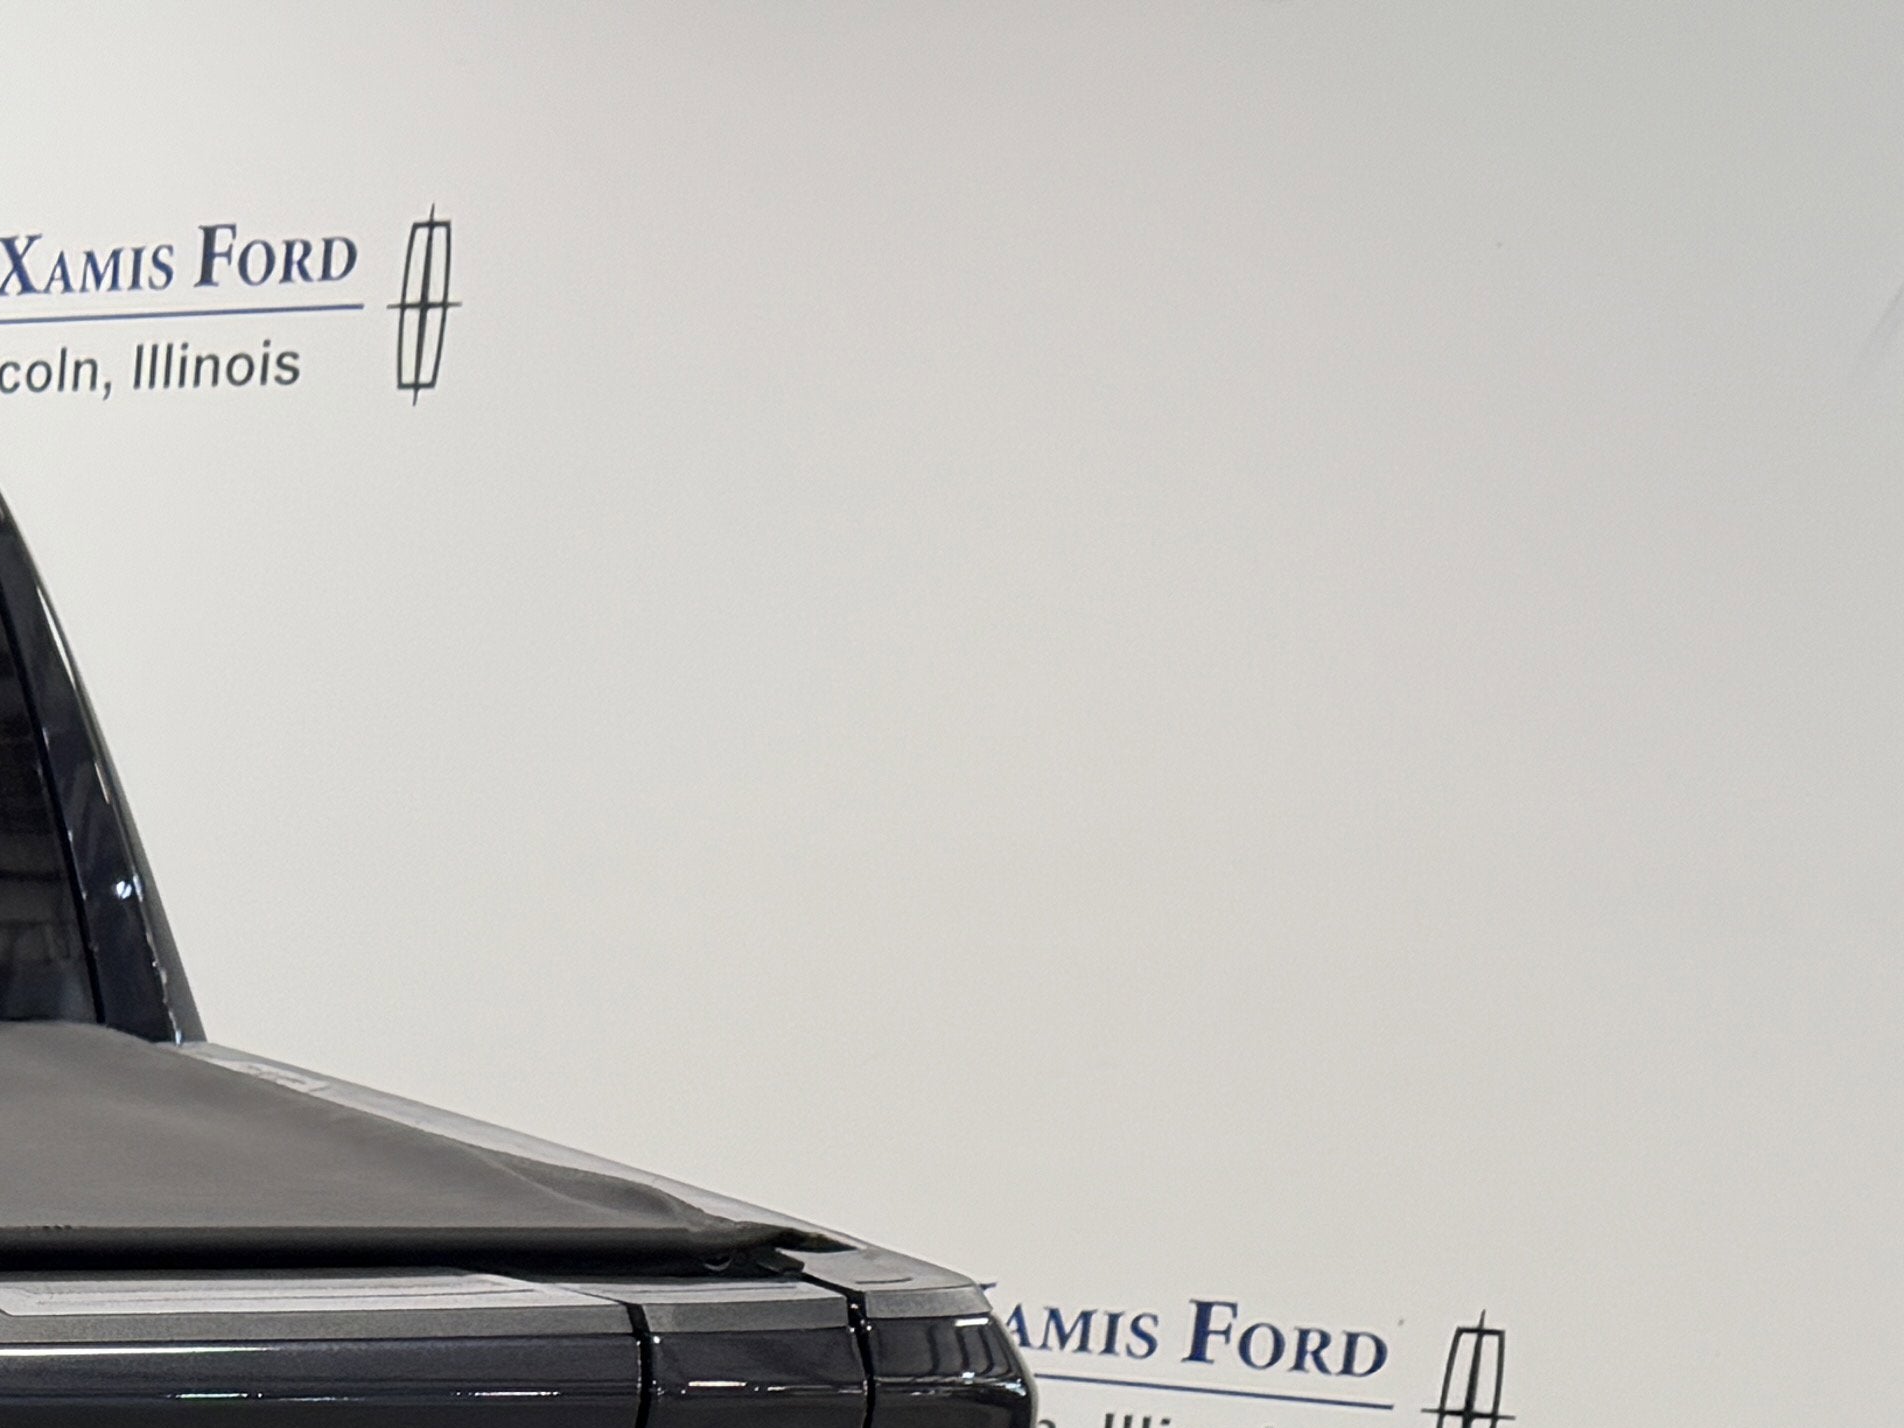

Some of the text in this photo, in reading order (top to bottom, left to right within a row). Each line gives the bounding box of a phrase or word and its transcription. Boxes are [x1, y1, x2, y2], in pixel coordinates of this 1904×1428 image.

[194, 222, 359, 288] FORD
[133, 338, 301, 389] Illinois
[1004, 1298, 1389, 1378] AMIS FORD
